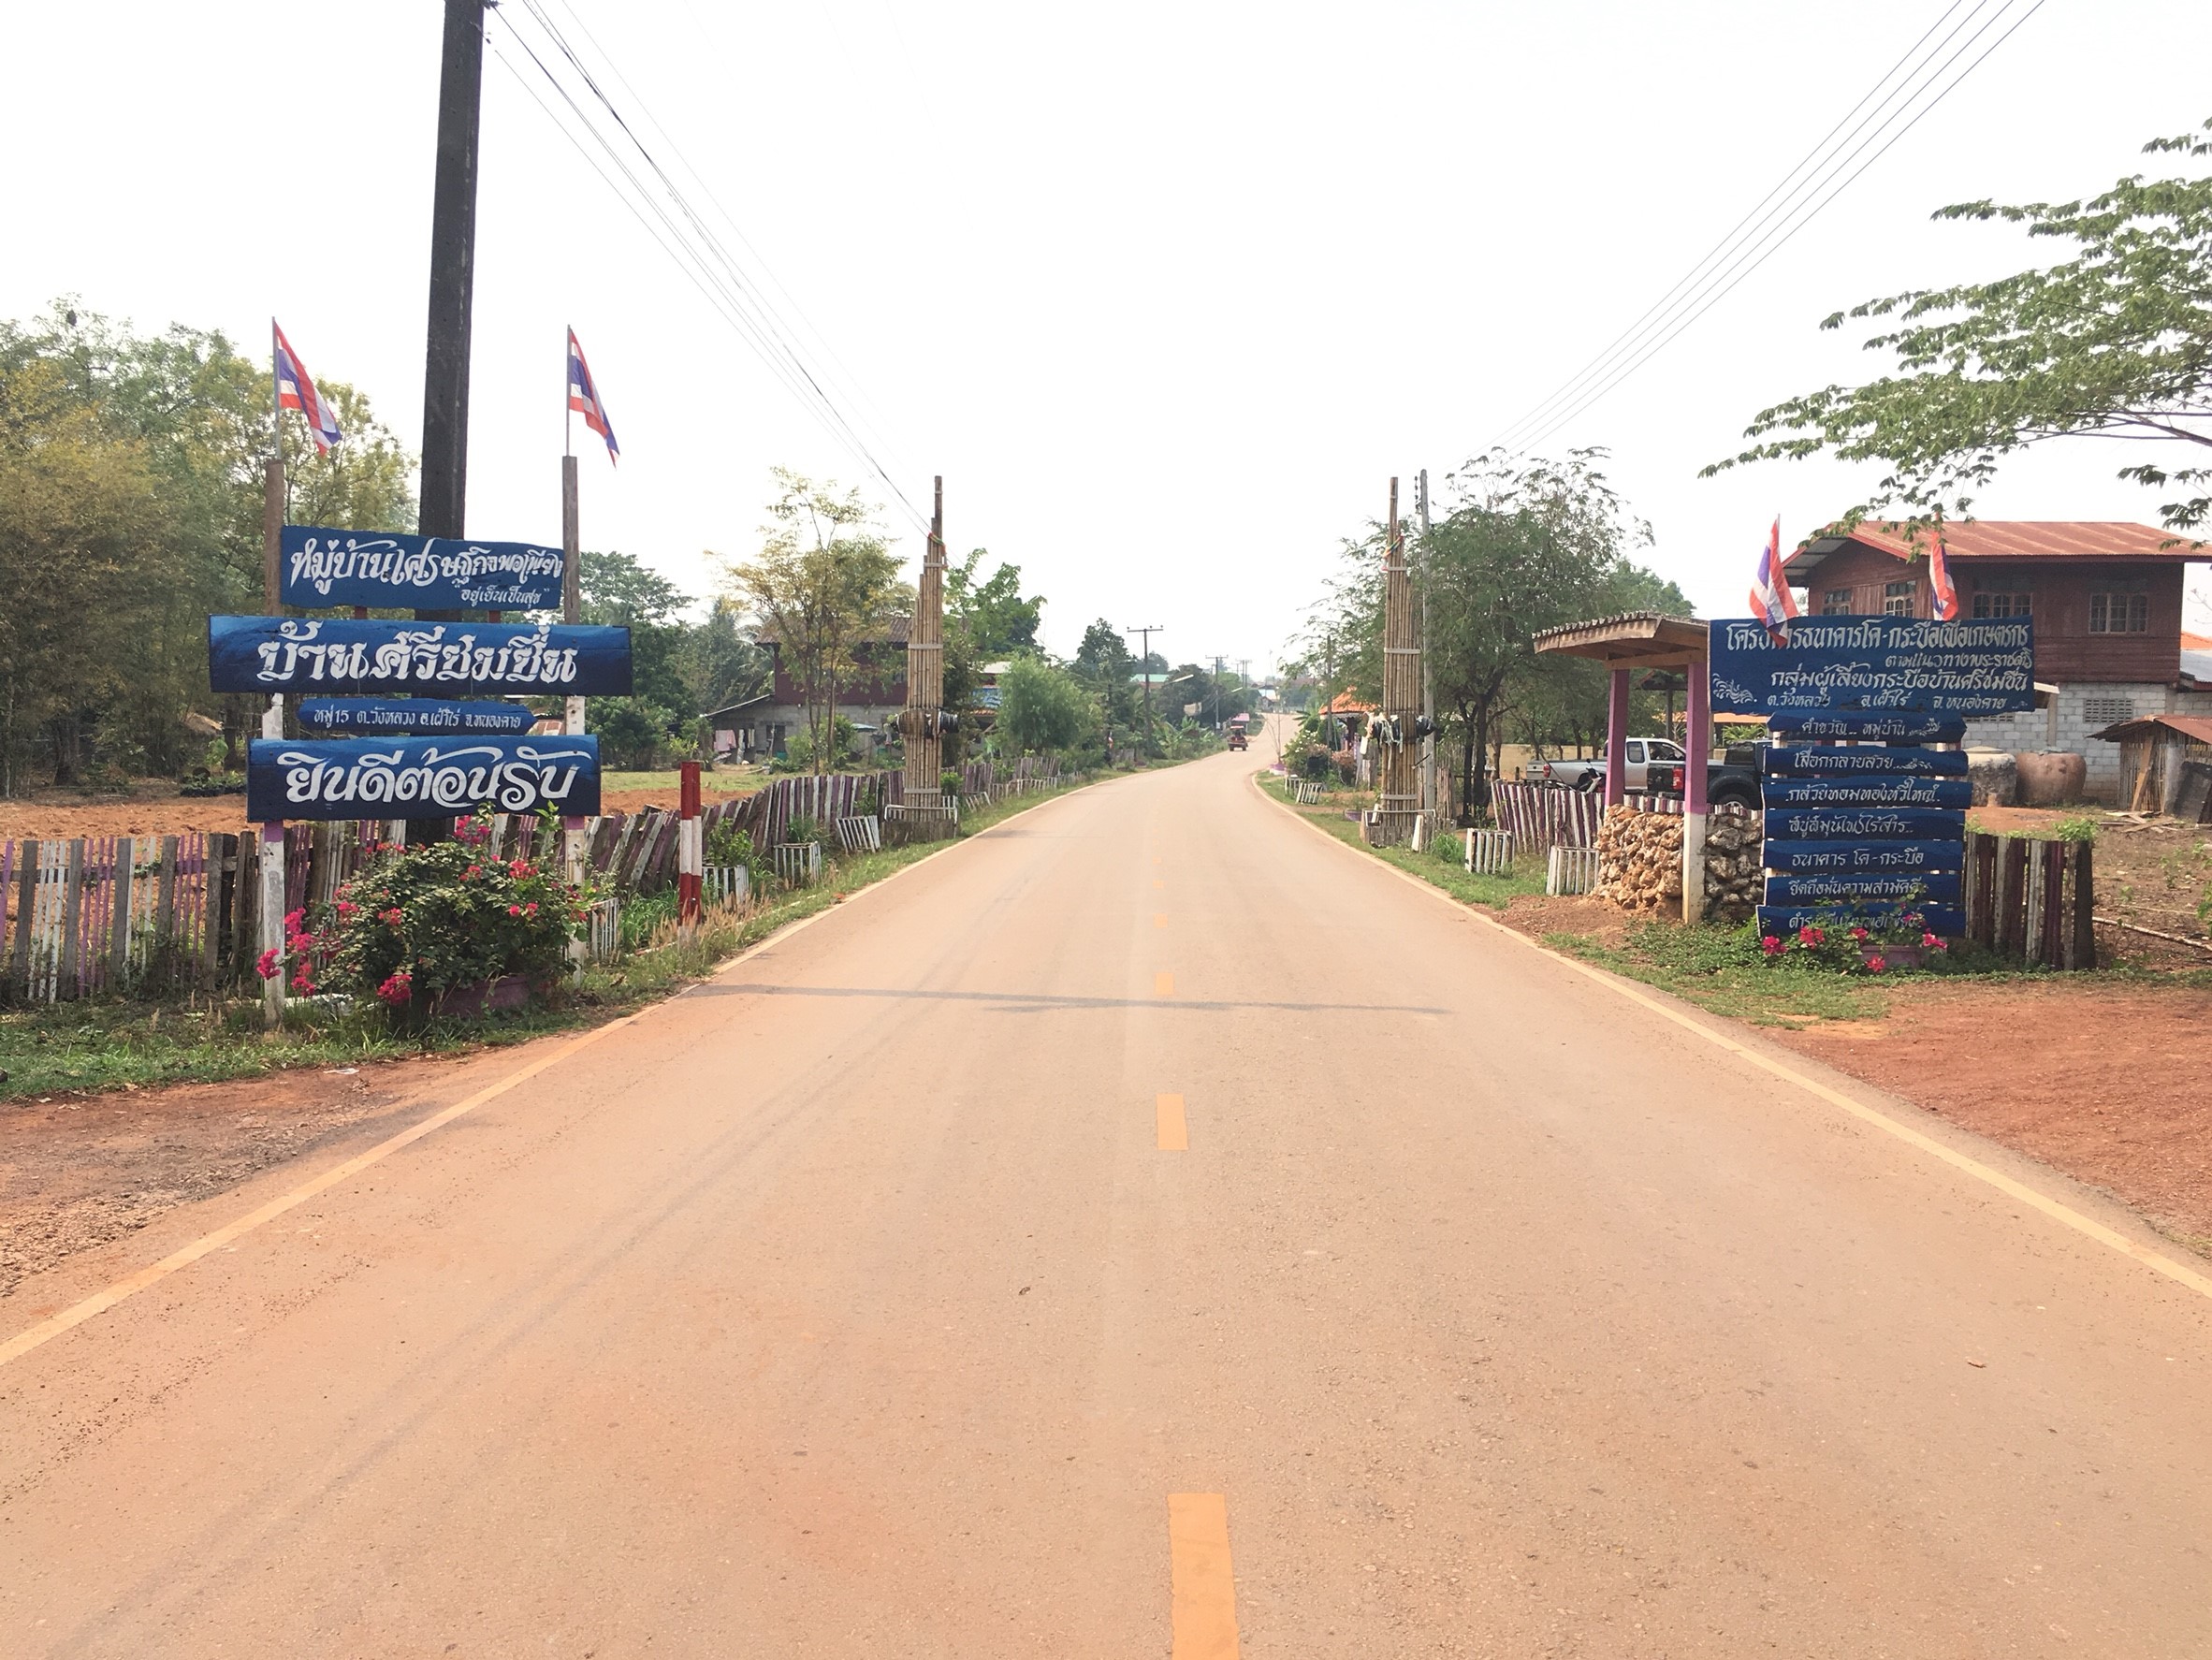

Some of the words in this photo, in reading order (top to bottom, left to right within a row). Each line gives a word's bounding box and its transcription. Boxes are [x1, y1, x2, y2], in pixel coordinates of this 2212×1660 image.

[290, 537, 563, 594] หมู่บ้านเศรษฐกิจพอเพียง
[1726, 618, 2030, 651] โครงารธนาคารโค-กระบือเพื่อเกษตรกร
[255, 621, 577, 682] บ้านศรีชมชื่น
[357, 707, 416, 725] ต.วังหลวง
[1862, 719, 1905, 740] หมู่บ้าน
[276, 745, 592, 811] ยินดีต้อนรับ
[1792, 852, 1847, 866] ธนาคาร
